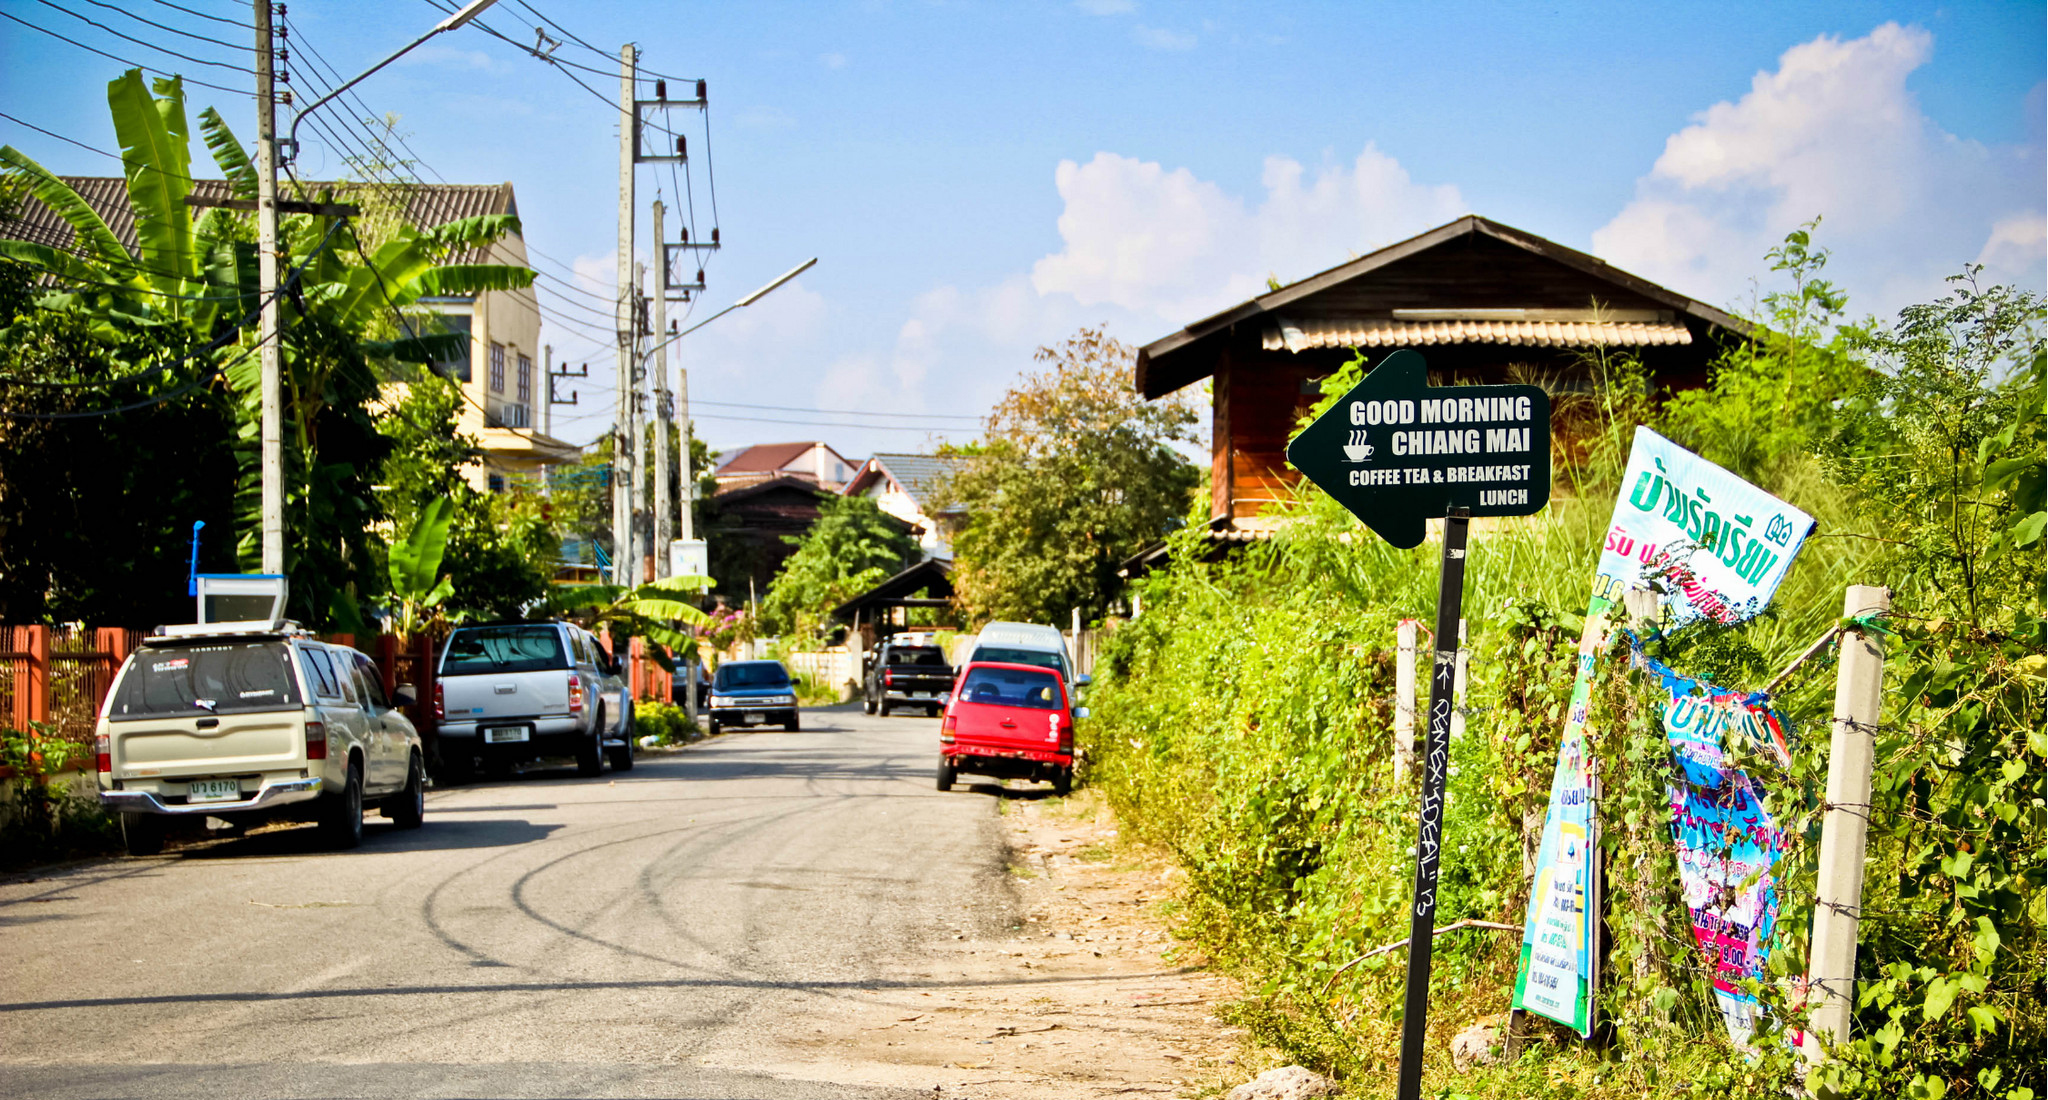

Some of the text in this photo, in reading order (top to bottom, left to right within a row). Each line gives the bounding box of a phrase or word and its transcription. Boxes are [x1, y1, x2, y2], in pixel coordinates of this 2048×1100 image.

[1350, 396, 1531, 425] GOOD MORNING
[1392, 428, 1530, 455] CHIANG MAI
[1349, 465, 1531, 486] COFFEE TEA & BREAKFAST
[1480, 489, 1528, 506] LUNCH
[210, 781, 236, 792] 6170
